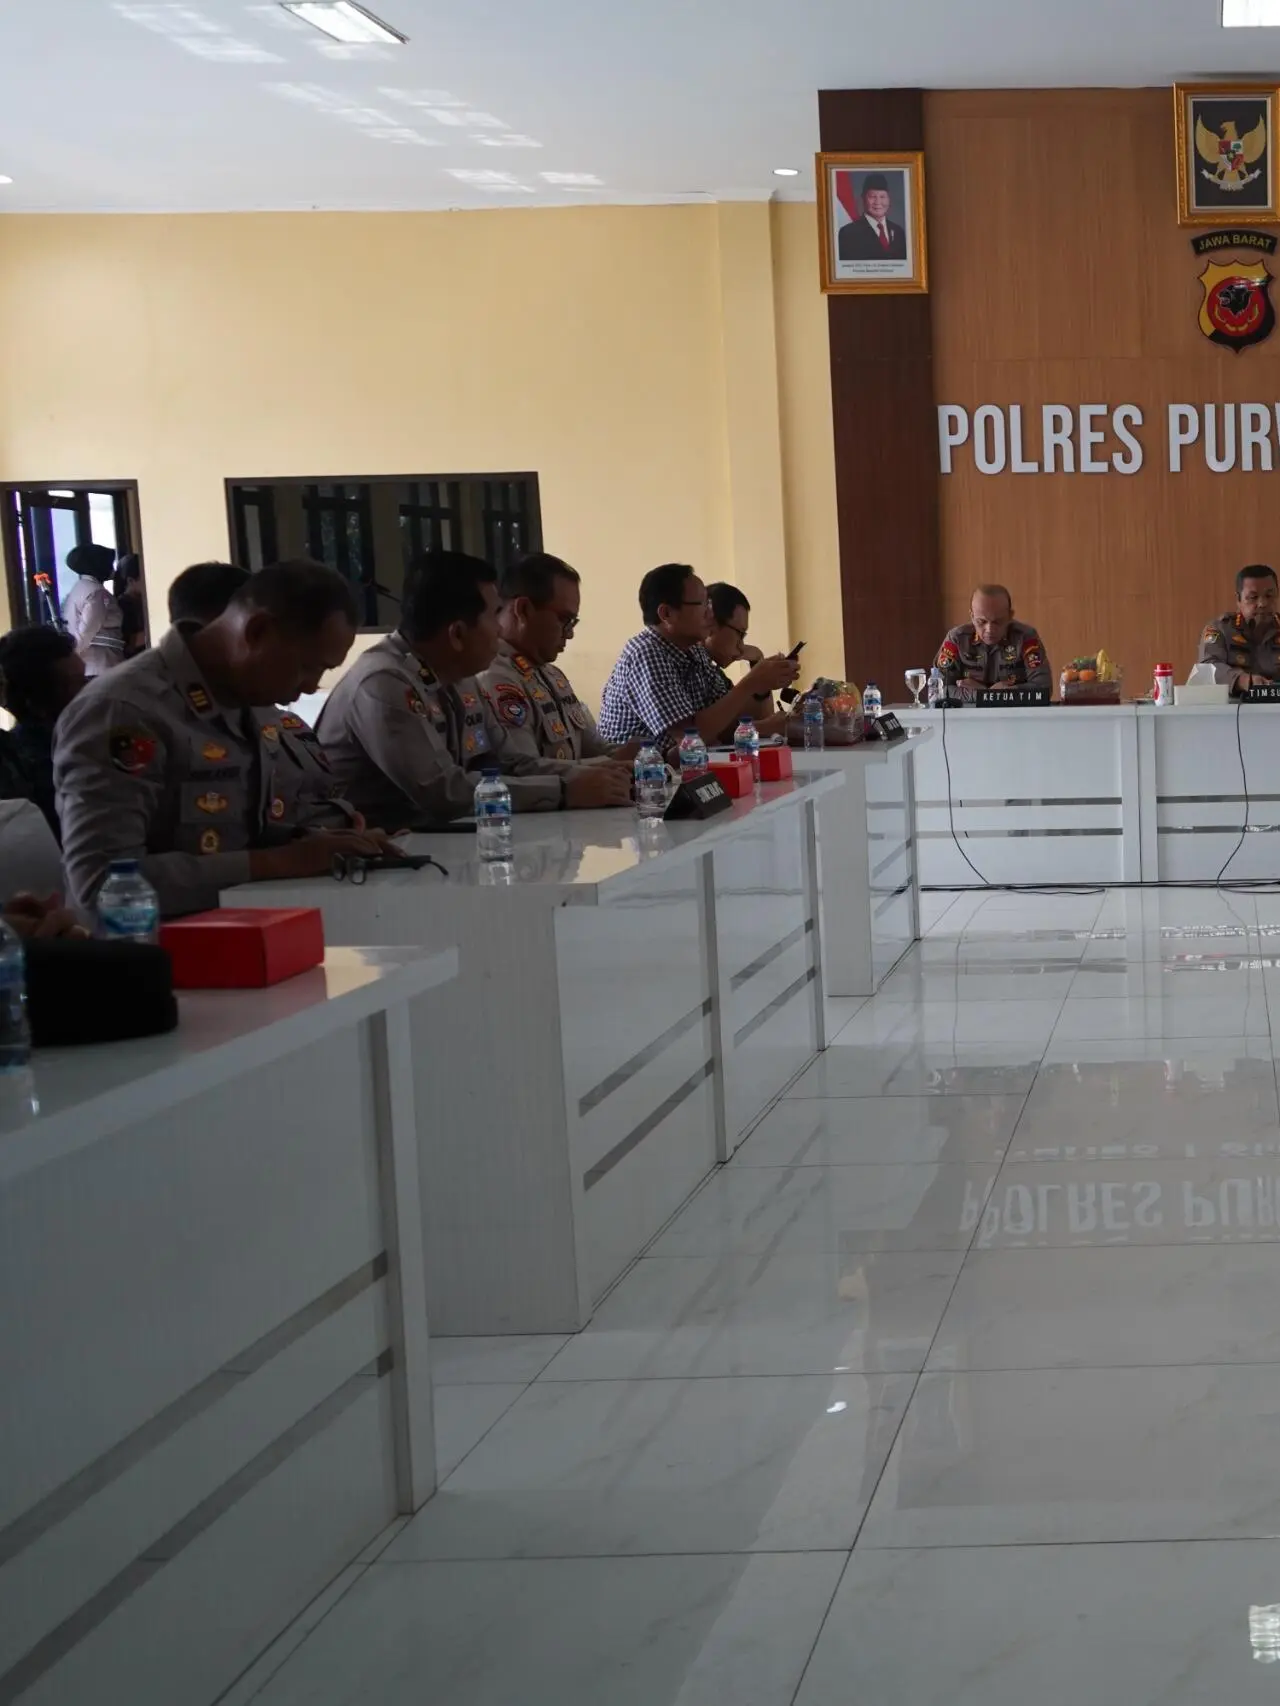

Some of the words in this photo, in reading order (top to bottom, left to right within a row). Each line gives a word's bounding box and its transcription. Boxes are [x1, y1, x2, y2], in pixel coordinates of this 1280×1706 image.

[1199, 235, 1231, 250] JAWA
[1233, 234, 1272, 249] BARAT
[937, 404, 1143, 474] POLRES
[983, 692, 1014, 701] KETUA
[1019, 692, 1042, 701] TIM
[1249, 689, 1268, 698] TIM
